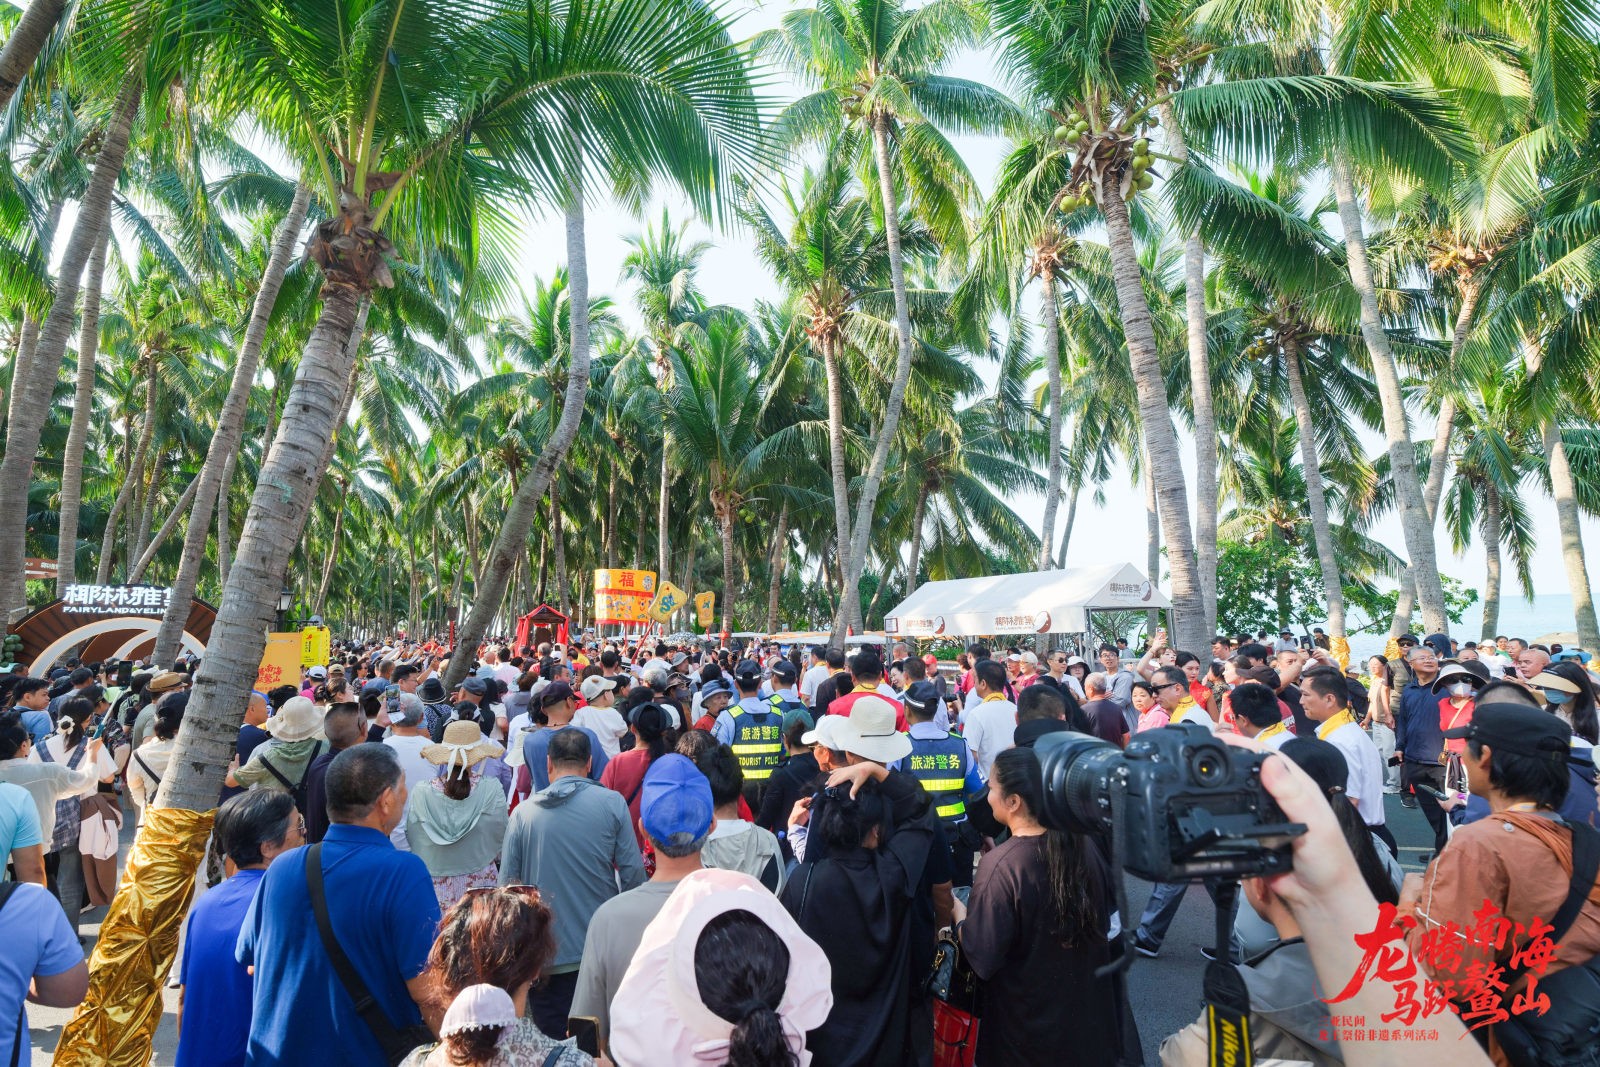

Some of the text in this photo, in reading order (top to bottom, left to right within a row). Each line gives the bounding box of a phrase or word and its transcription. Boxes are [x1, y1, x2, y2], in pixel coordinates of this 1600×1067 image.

[619, 572, 635, 587] 福
[741, 726, 779, 740] 旅游警察
[739, 757, 761, 766] TOURIST
[911, 754, 960, 770] 旅游警务
